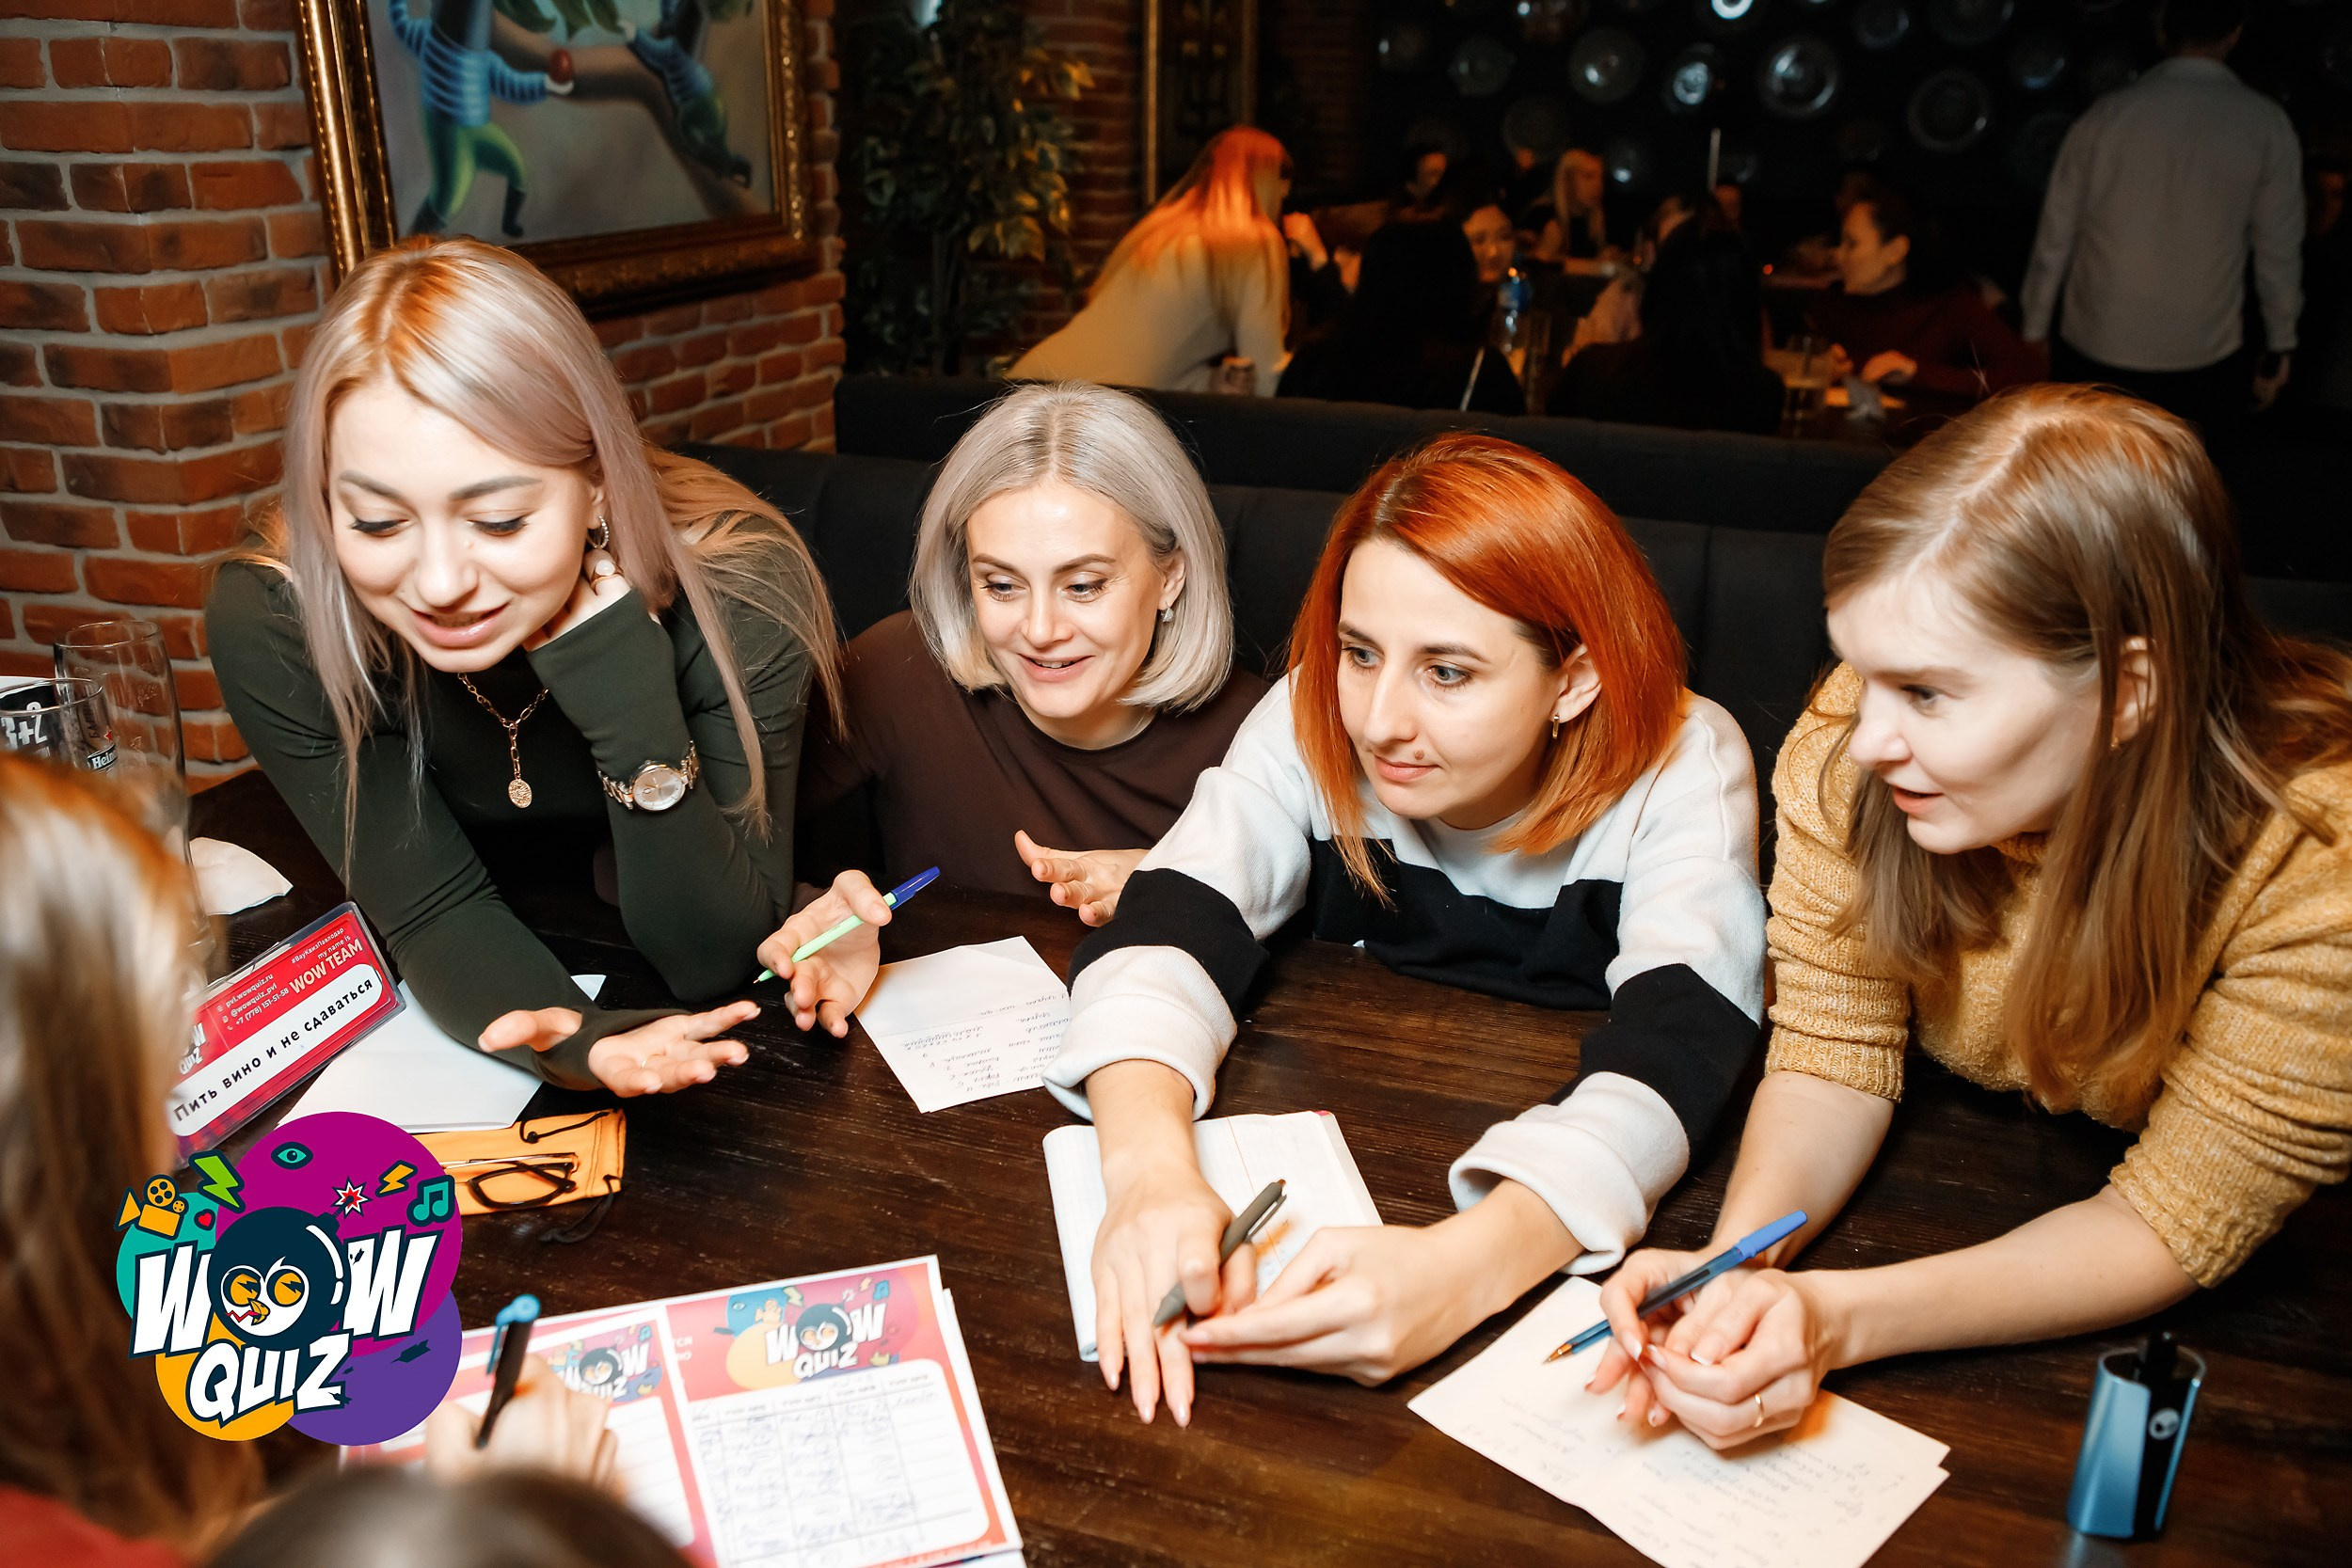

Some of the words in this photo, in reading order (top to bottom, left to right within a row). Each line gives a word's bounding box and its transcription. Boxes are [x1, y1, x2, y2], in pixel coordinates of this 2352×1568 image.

[289, 961, 327, 994] WOW
[326, 939, 363, 970] TEAM
[317, 950, 327, 959] my
[327, 940, 344, 953] name
[226, 974, 274, 1008] pvl.wowquiz.ru
[173, 1089, 217, 1121] Пить
[222, 1057, 262, 1088] вино
[266, 1046, 278, 1059] и
[280, 1031, 300, 1049] не
[304, 979, 373, 1033] сдаваться
[793, 1342, 860, 1379] QUIZ
